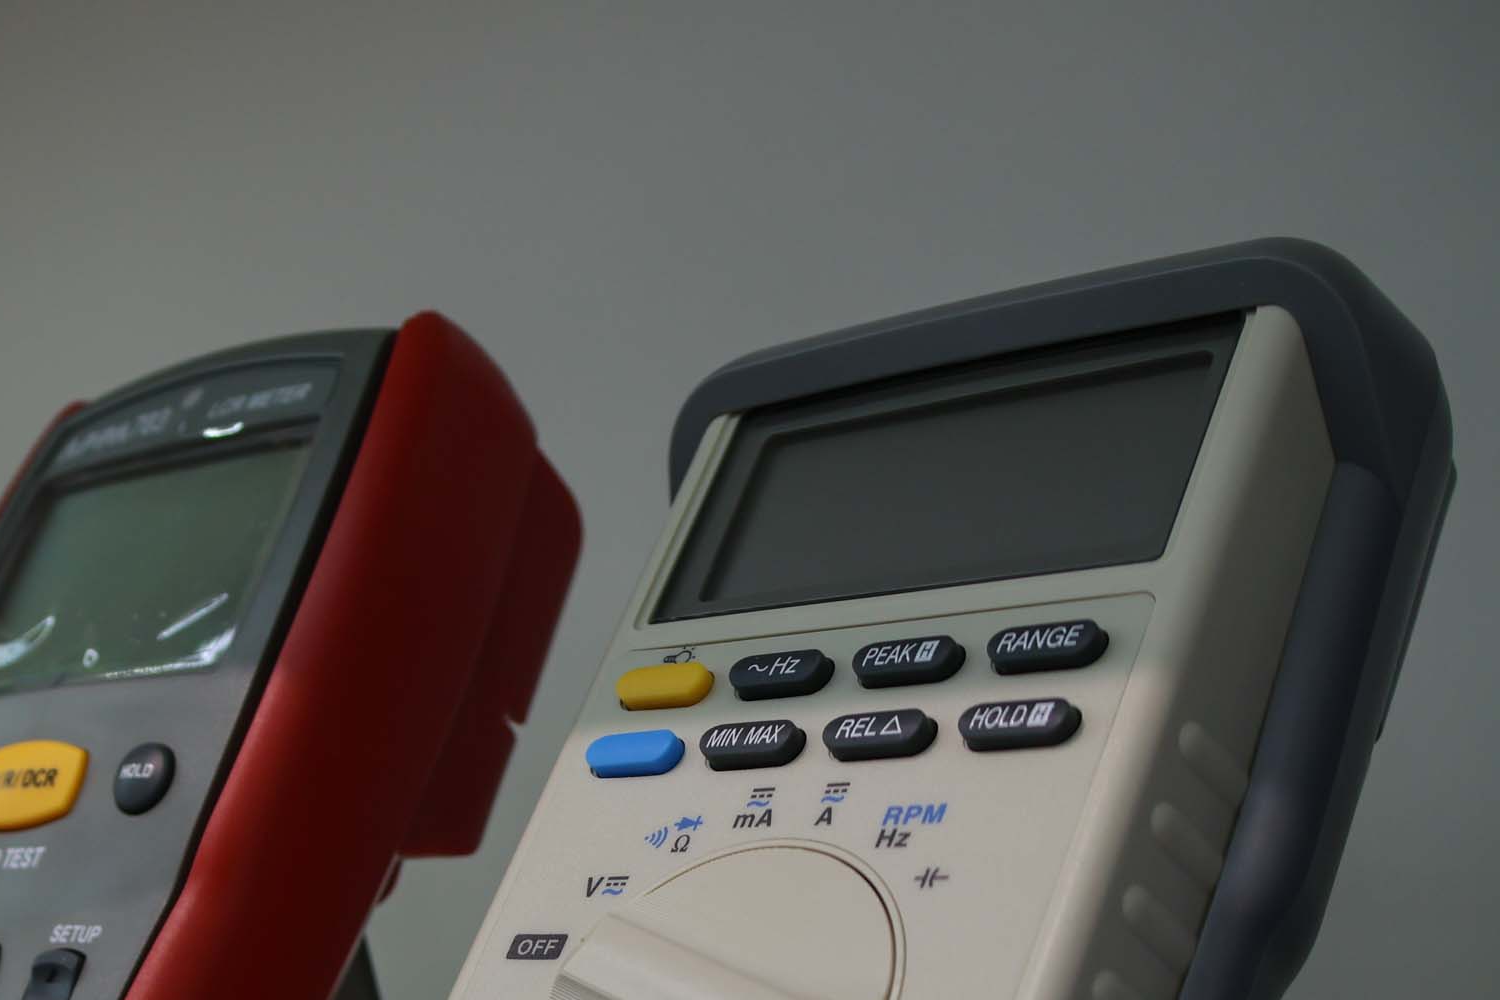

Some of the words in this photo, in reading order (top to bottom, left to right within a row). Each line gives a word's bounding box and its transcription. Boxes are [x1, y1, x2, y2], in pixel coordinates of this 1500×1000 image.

[996, 624, 1084, 654] RANGE
[862, 643, 915, 667] PEAK
[969, 705, 1027, 729] HOLD
[706, 725, 743, 748] MIN
[743, 723, 785, 745] MAX
[835, 717, 876, 739] REL
[120, 763, 155, 779] HOLD
[732, 808, 773, 828] mA
[814, 807, 833, 827] A
[882, 803, 947, 826] RPM
[875, 828, 911, 848] Hz
[3, 847, 46, 868] TEST
[49, 923, 102, 944] SETUP
[517, 939, 559, 955] OFF
